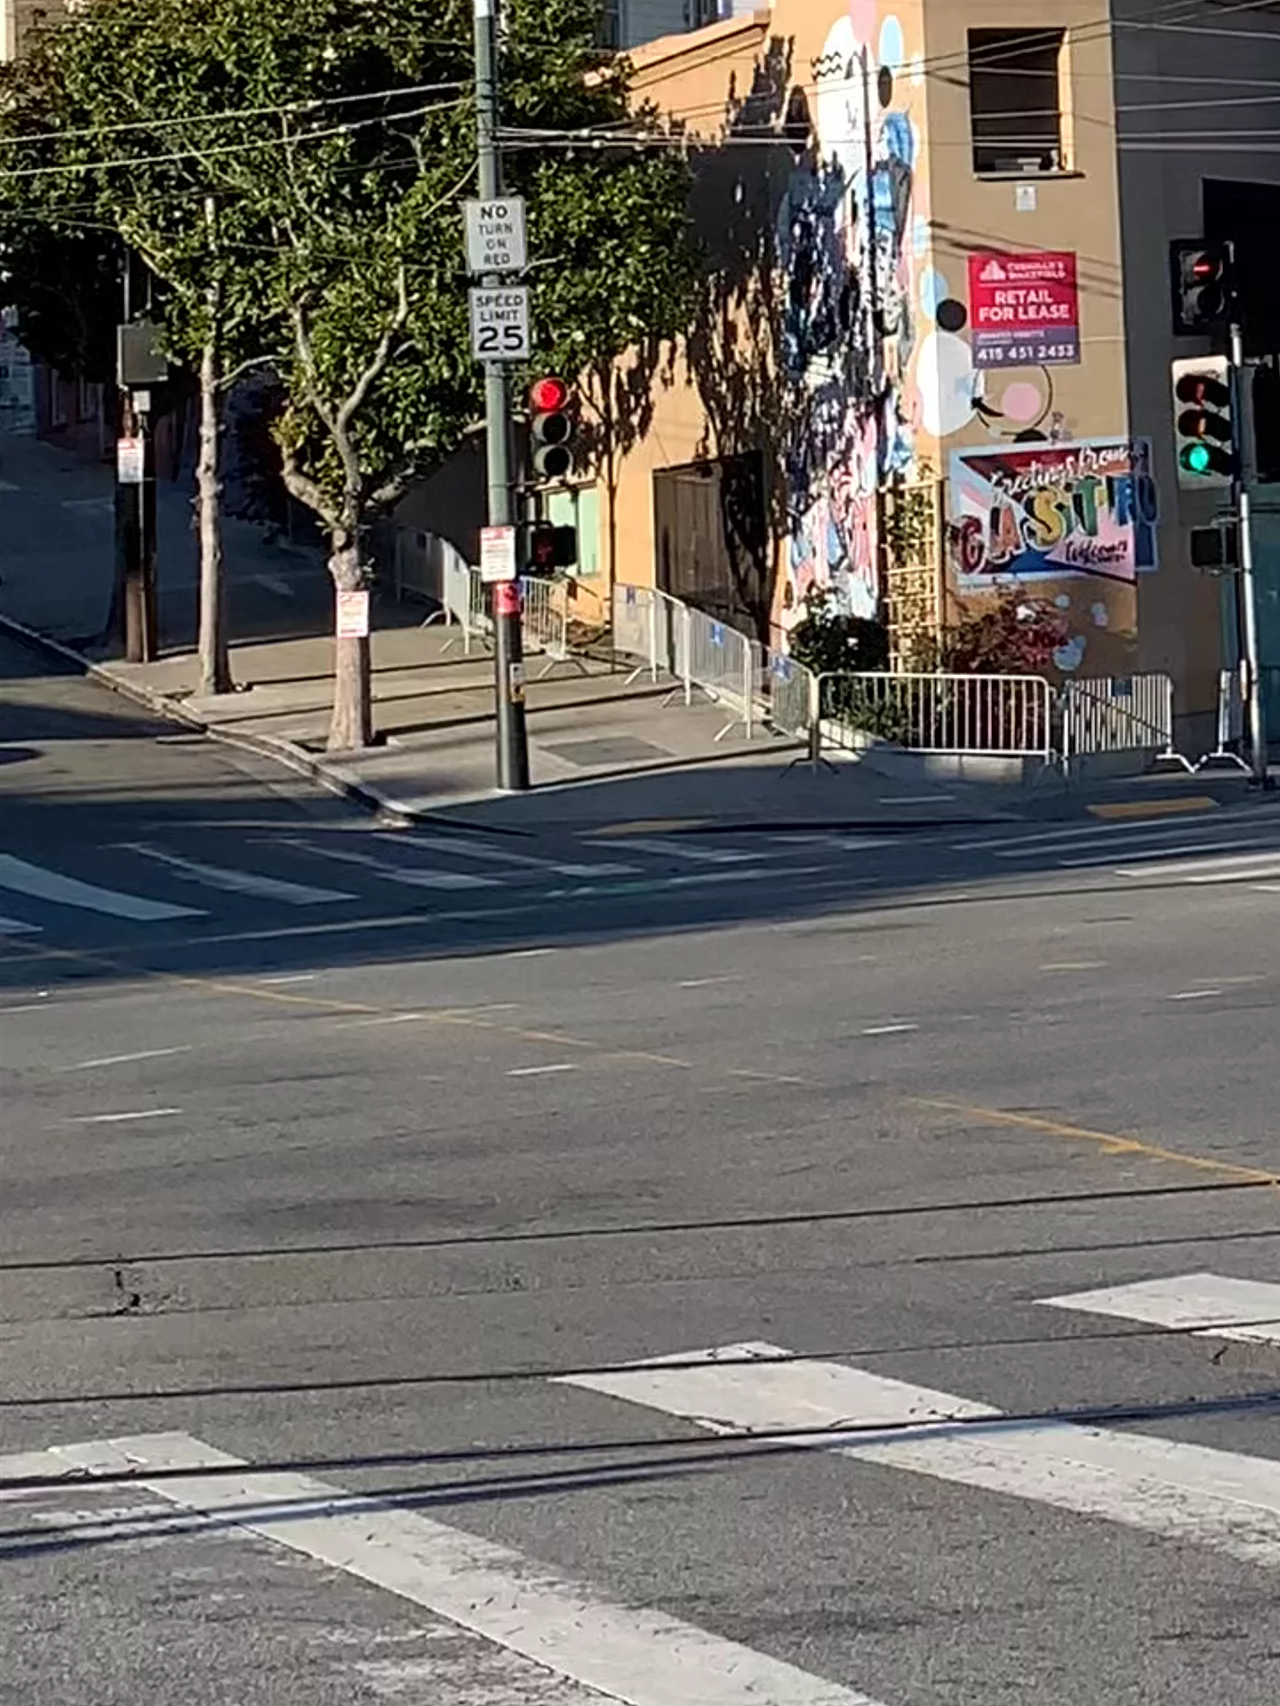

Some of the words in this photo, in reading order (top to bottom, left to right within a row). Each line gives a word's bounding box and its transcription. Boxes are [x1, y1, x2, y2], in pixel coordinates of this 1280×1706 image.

[480, 204, 508, 220] NO
[479, 223, 512, 235] TURN
[486, 239, 506, 250] ON
[484, 253, 510, 265] RED
[476, 295, 523, 308] SPEED
[994, 289, 1053, 305] RETAIL
[480, 310, 518, 322] LIMIT
[979, 306, 1014, 322] FOR
[1018, 304, 1070, 319] LEASE
[478, 325, 523, 351] 25
